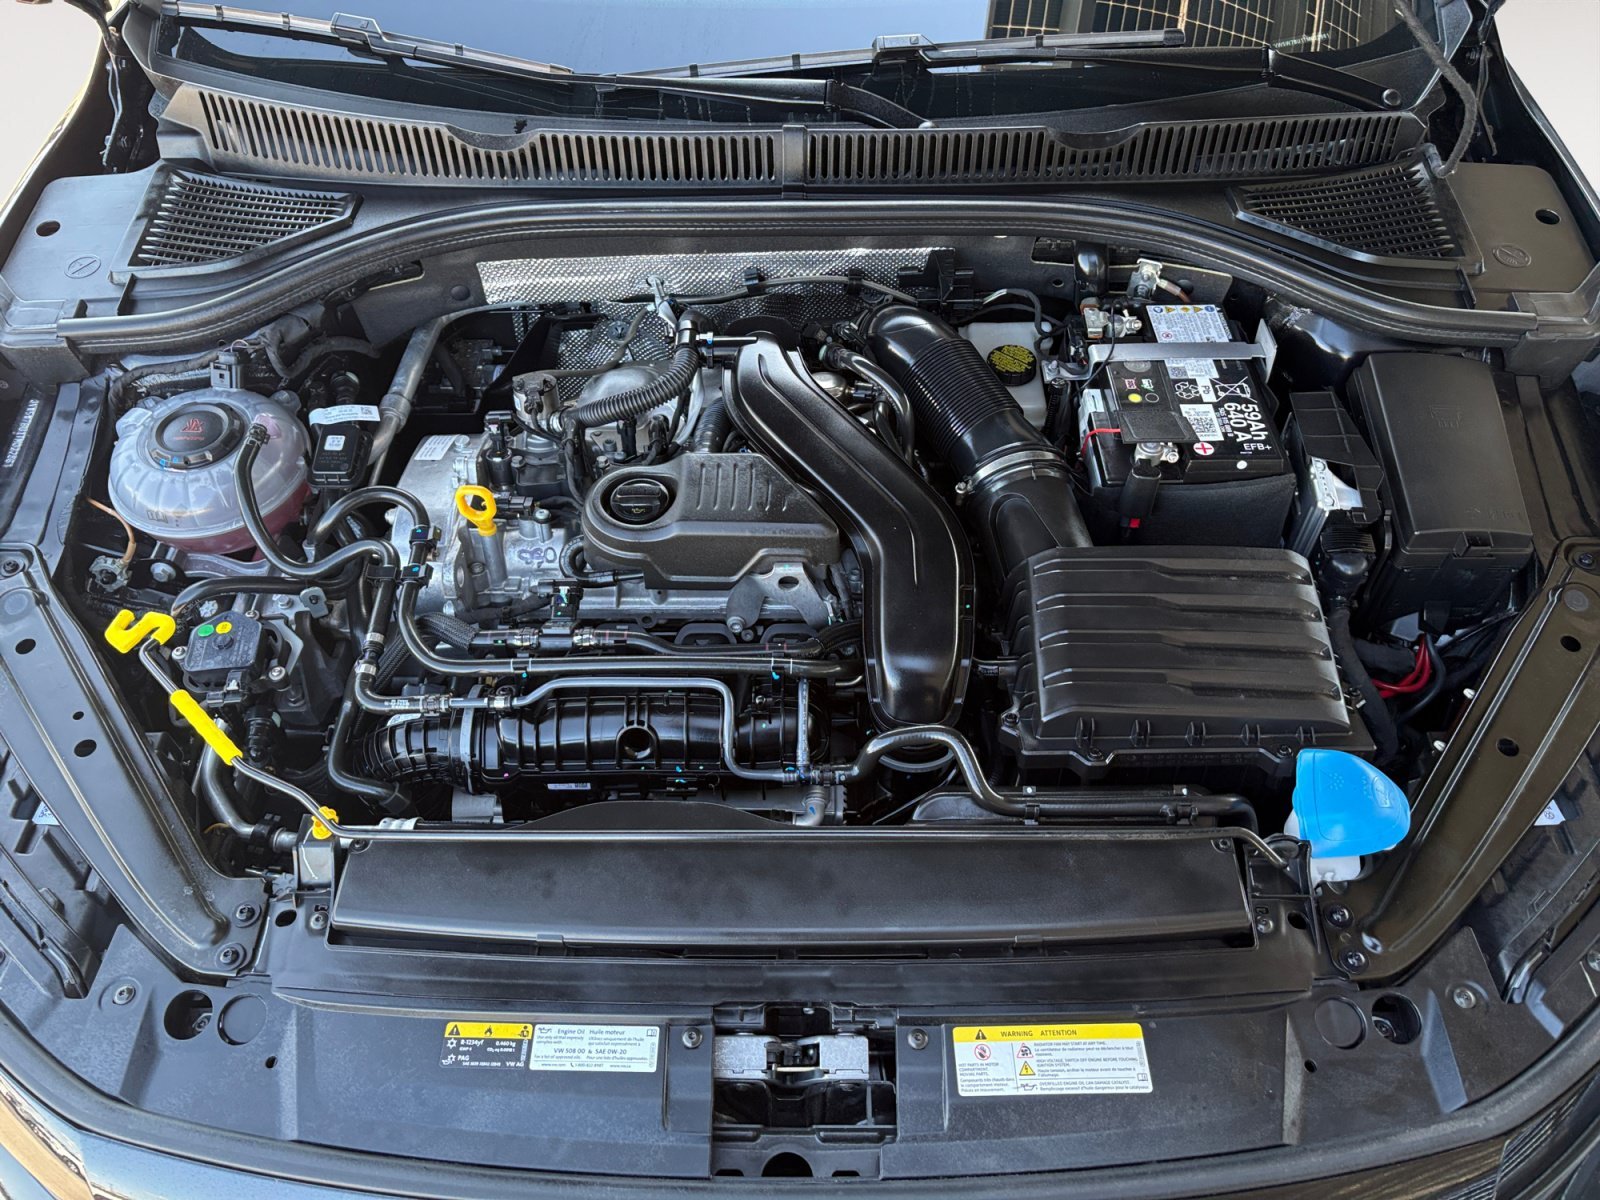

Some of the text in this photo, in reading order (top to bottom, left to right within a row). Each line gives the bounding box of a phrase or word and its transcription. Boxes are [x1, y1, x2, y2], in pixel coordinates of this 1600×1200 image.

[1224, 402, 1247, 428] 640
[1242, 403, 1268, 440] 59Ah
[1233, 430, 1252, 442] A
[1243, 443, 1272, 451] EFB+
